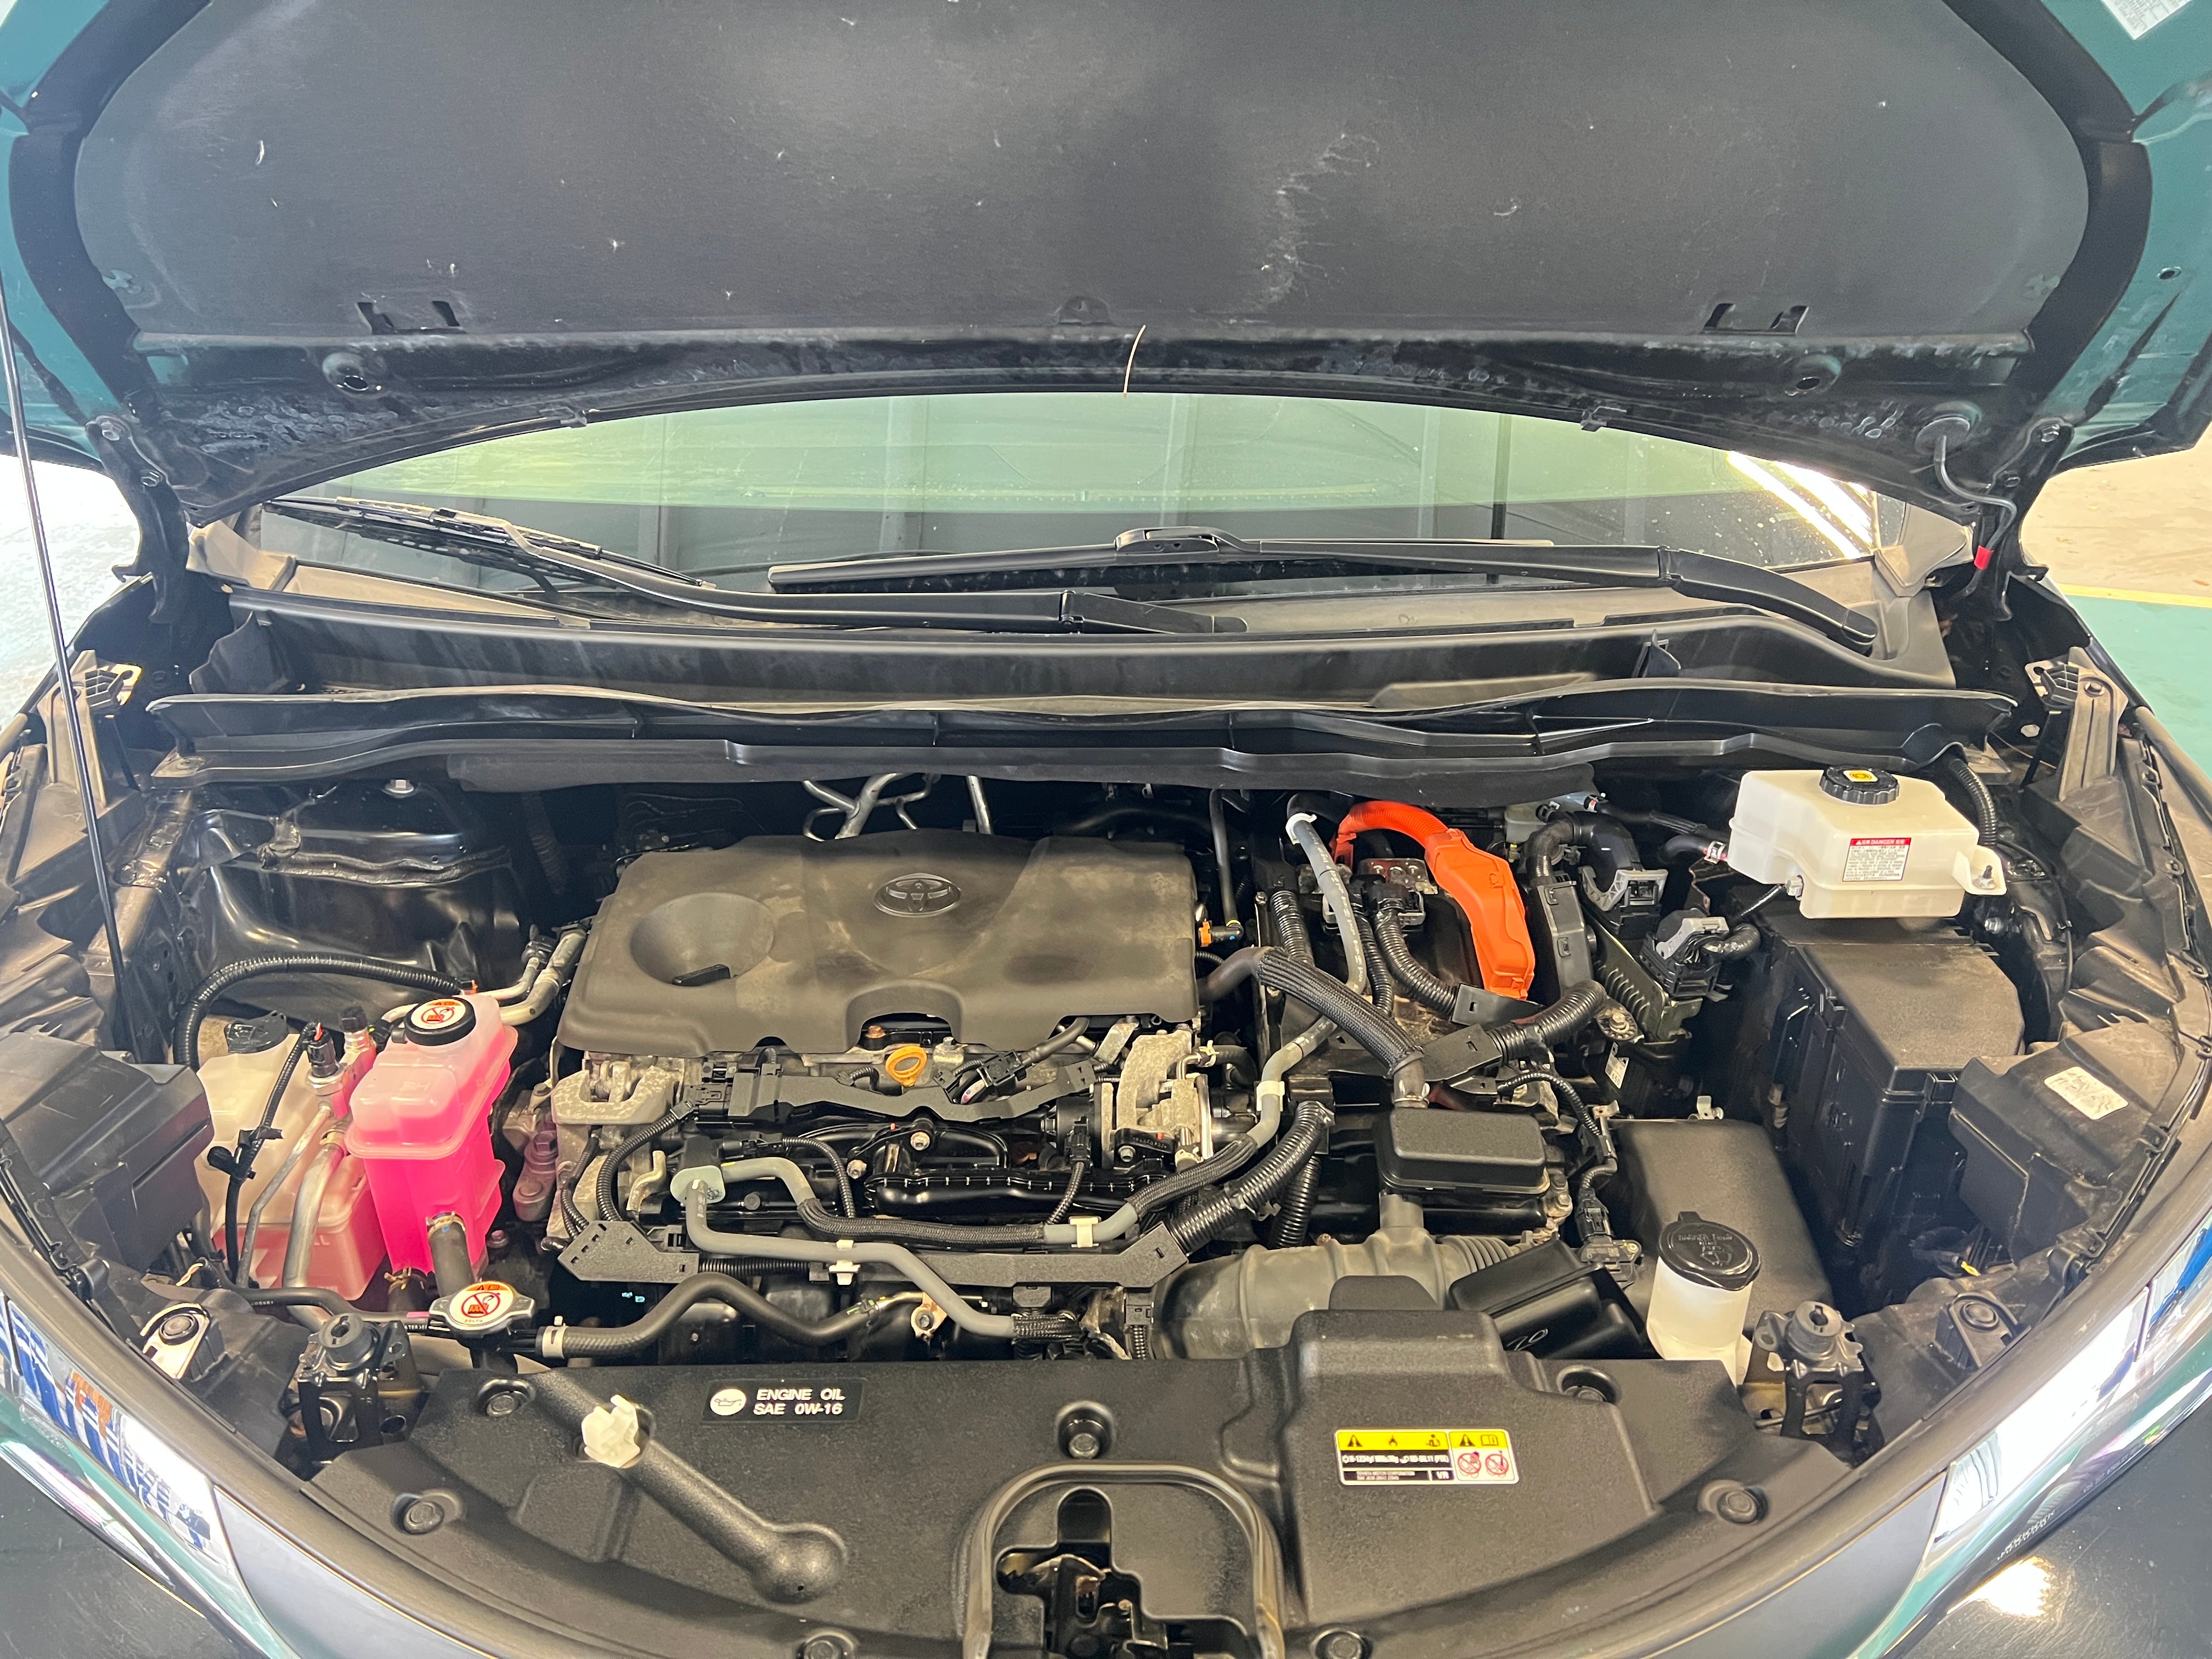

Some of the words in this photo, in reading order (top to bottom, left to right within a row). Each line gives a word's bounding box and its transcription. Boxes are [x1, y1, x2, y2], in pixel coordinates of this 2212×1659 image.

[756, 1389, 812, 1401] ENGINE
[820, 1389, 845, 1401] OIL
[753, 1403, 786, 1415] SAE
[794, 1403, 843, 1415] 0W-16
